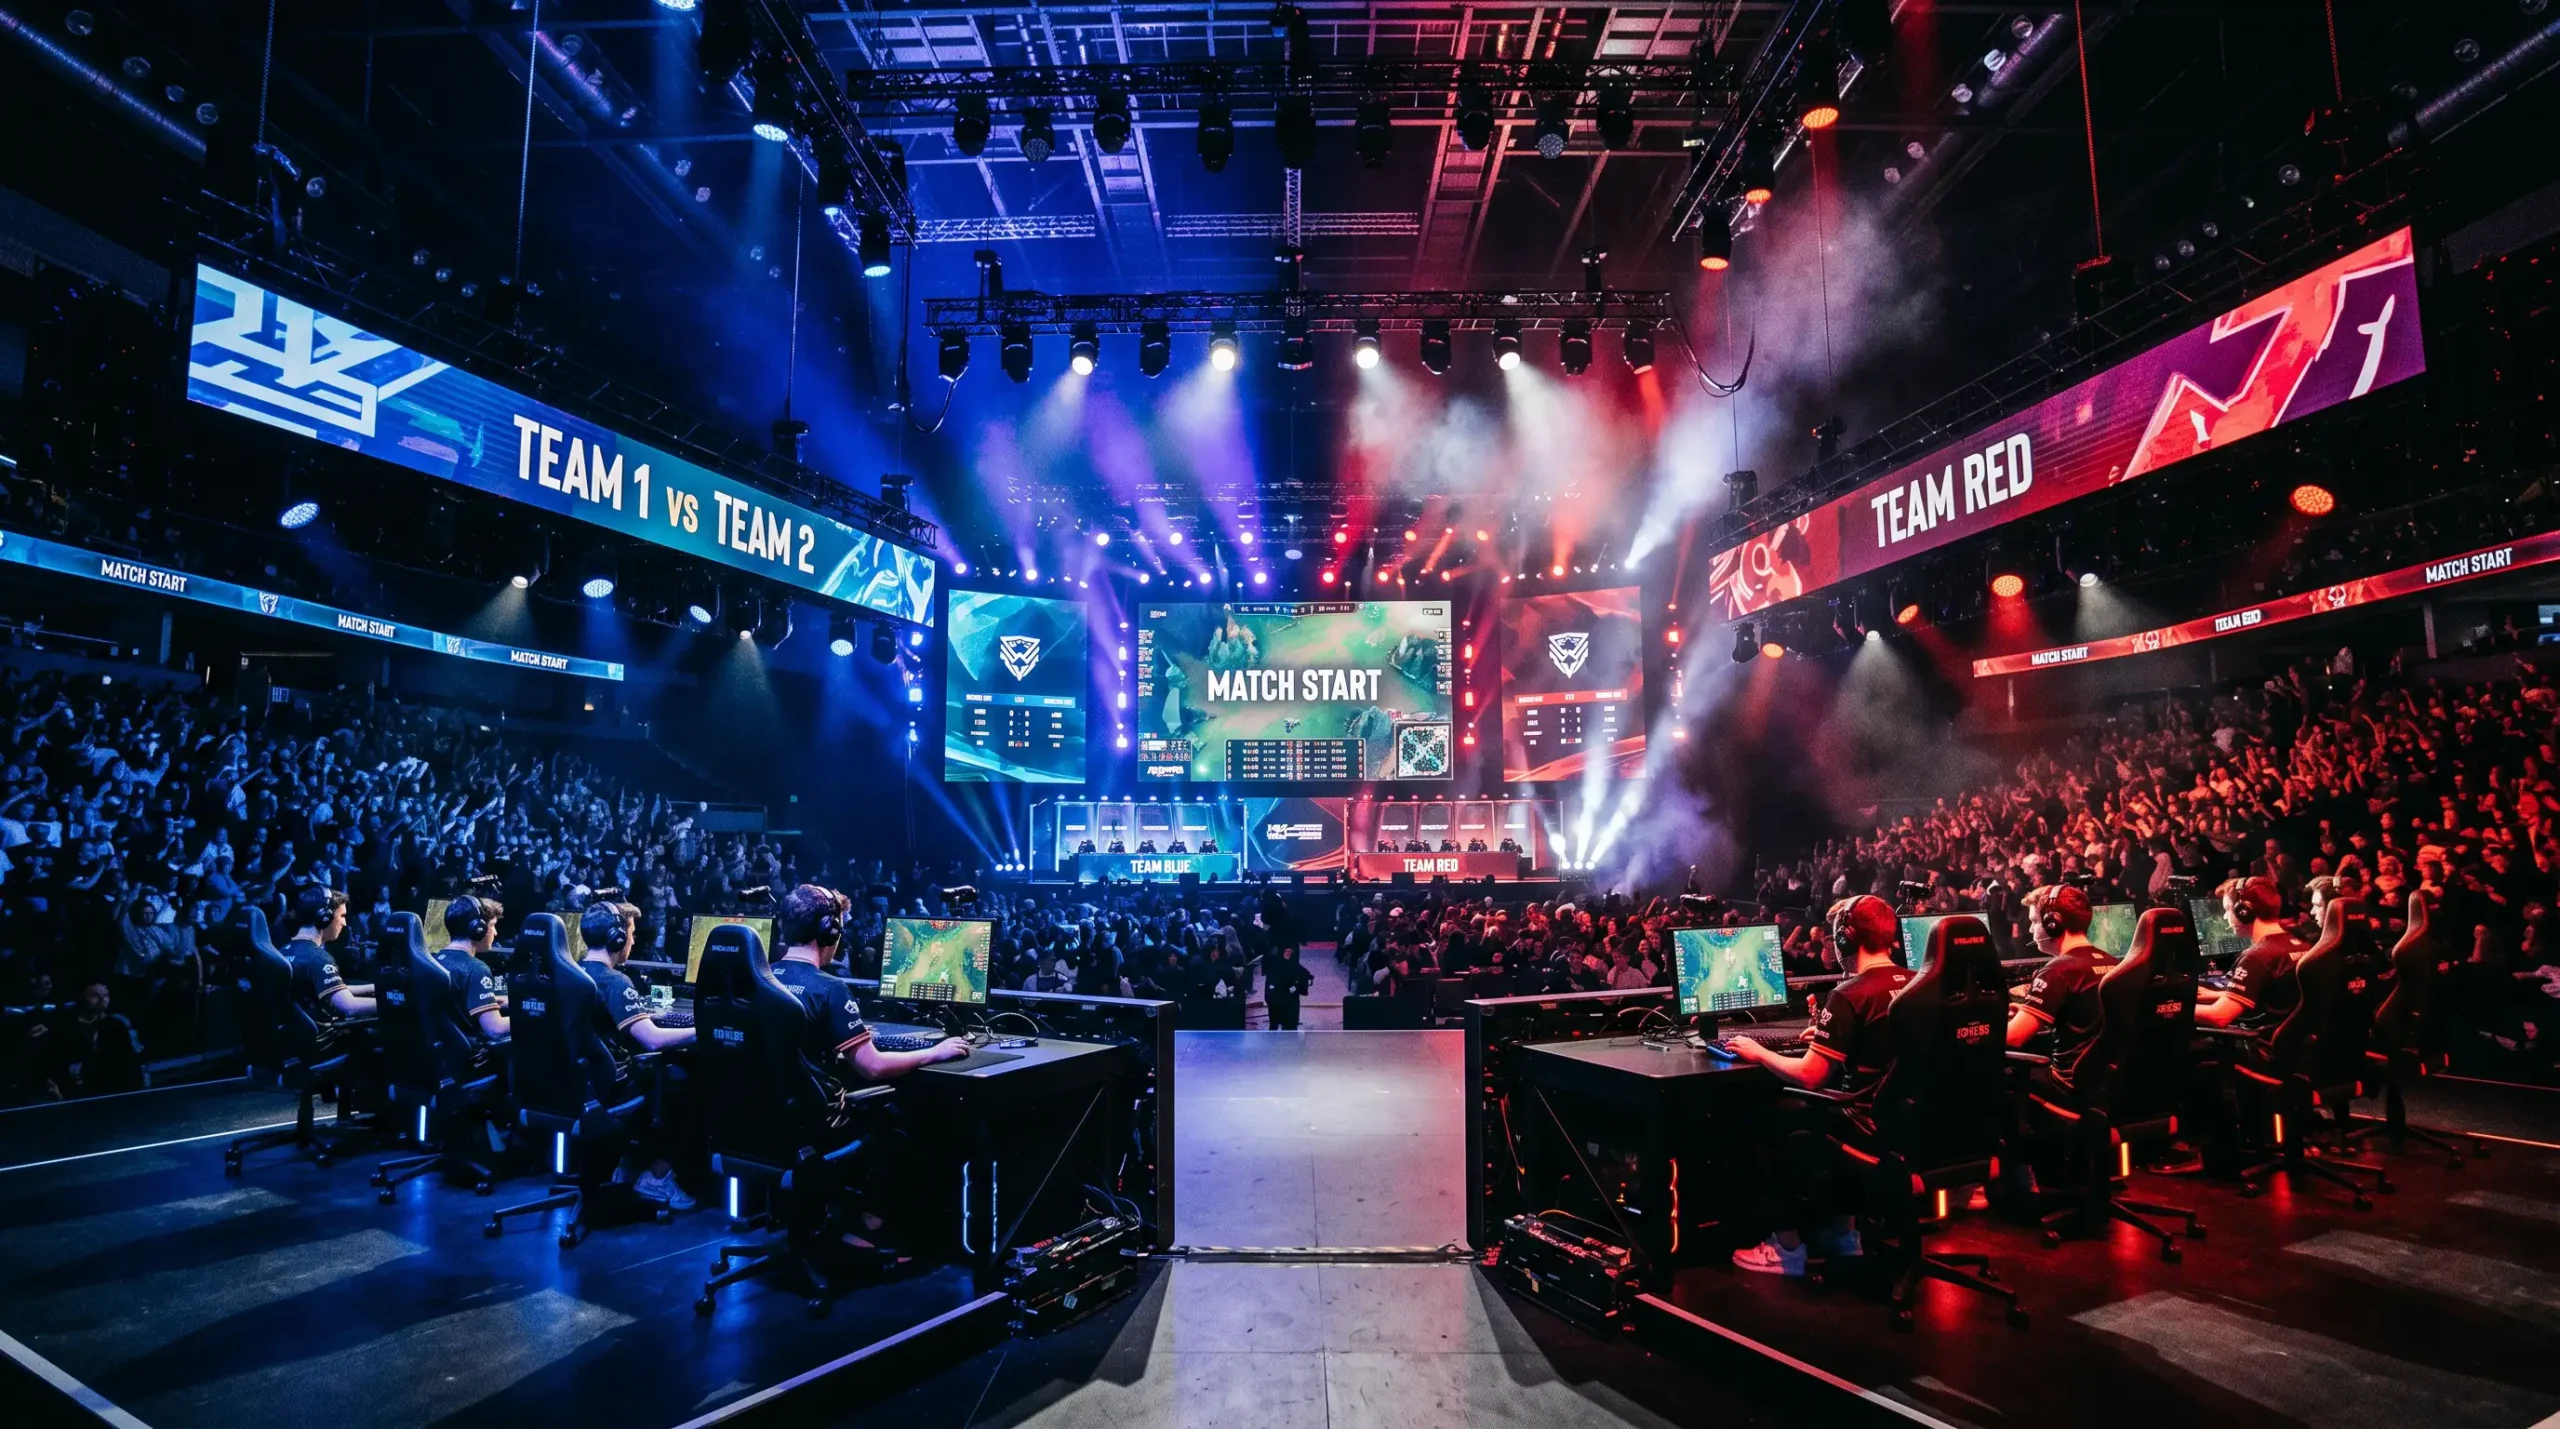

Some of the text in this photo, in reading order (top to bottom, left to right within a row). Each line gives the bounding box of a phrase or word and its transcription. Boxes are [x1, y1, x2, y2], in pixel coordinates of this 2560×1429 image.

[513, 413, 624, 512] TEAM
[633, 463, 650, 520] 1
[713, 490, 792, 566] TEAM
[798, 523, 815, 575] 2
[1870, 432, 2033, 549] TEAM RED
[101, 558, 187, 593] MATCH START
[2425, 547, 2513, 584] MATCH START
[337, 613, 368, 633] MATCH
[510, 649, 569, 670] MATCH START
[2031, 646, 2089, 666] MATCH START
[1207, 668, 1382, 702] MATCH START
[1130, 859, 1192, 874] TEAM BLUE
[1402, 858, 1459, 873] TEAM RED
